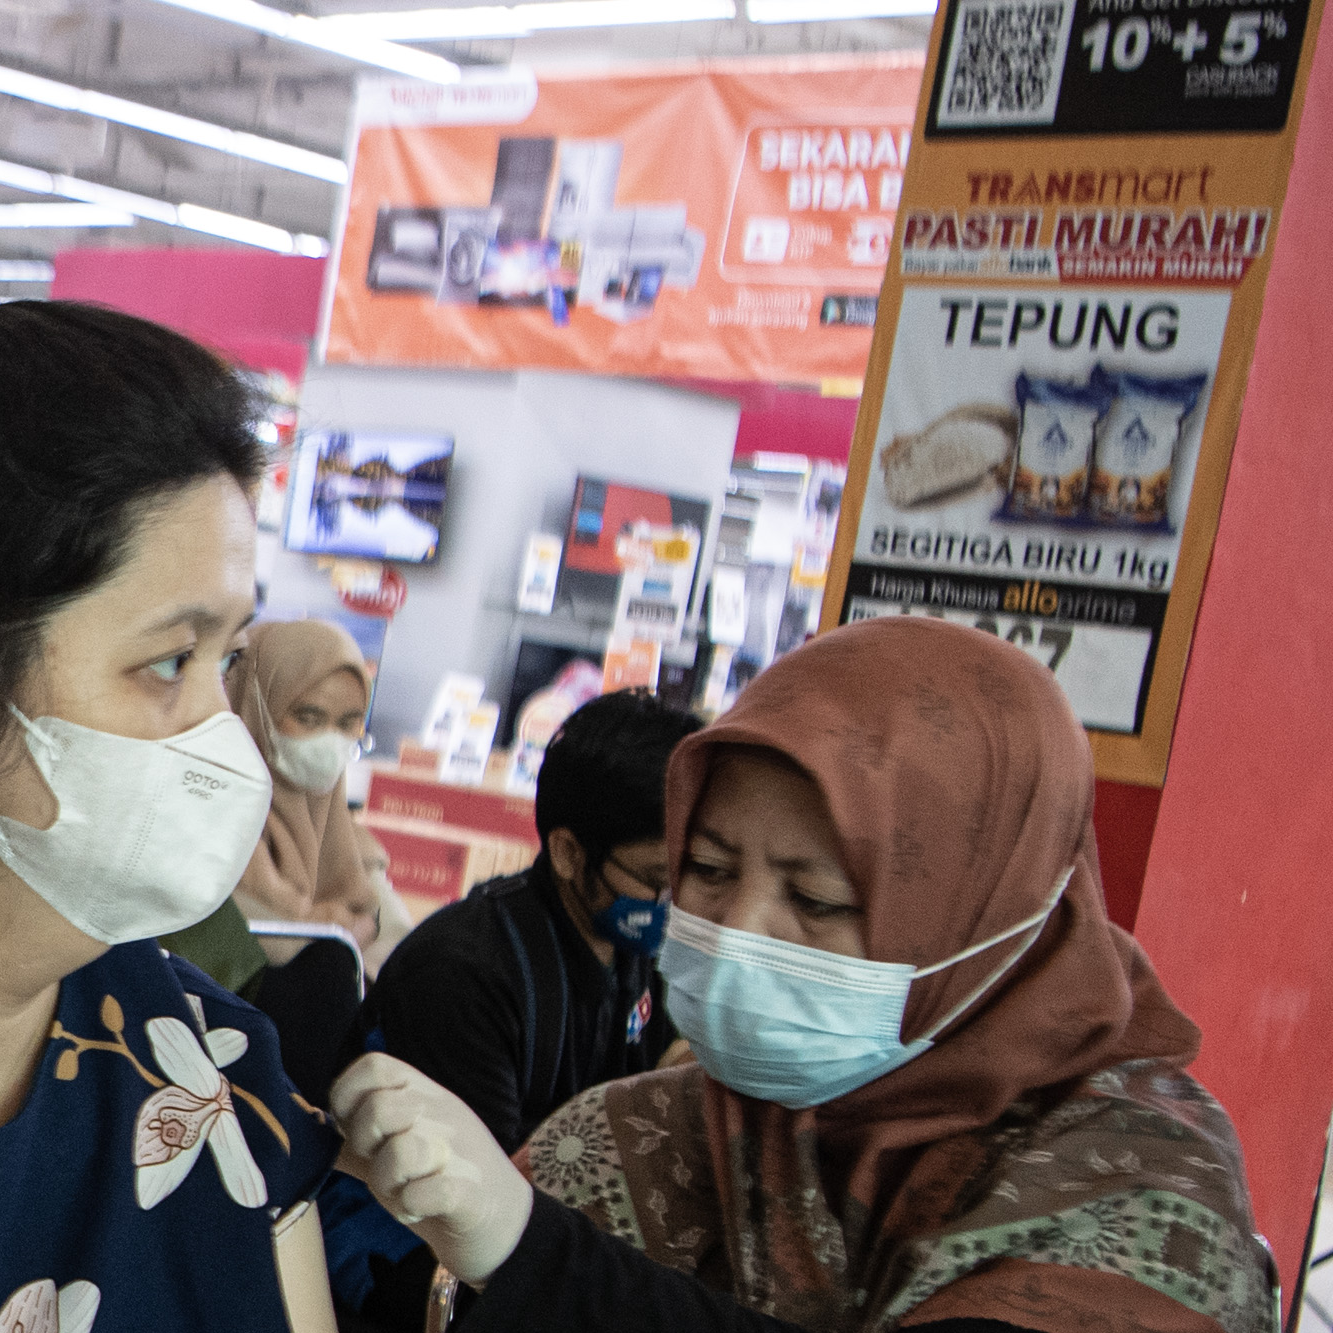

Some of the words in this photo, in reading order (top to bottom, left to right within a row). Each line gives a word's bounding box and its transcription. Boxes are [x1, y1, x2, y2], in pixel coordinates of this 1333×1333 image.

[901, 208, 1043, 250] PASTI
[1053, 207, 1270, 254] MURAH!
[940, 299, 1178, 352] TEPUNG
[871, 526, 1013, 568] SEGITIGA
[1023, 540, 1102, 574] BIRU
[1115, 547, 1169, 590] 1kg
